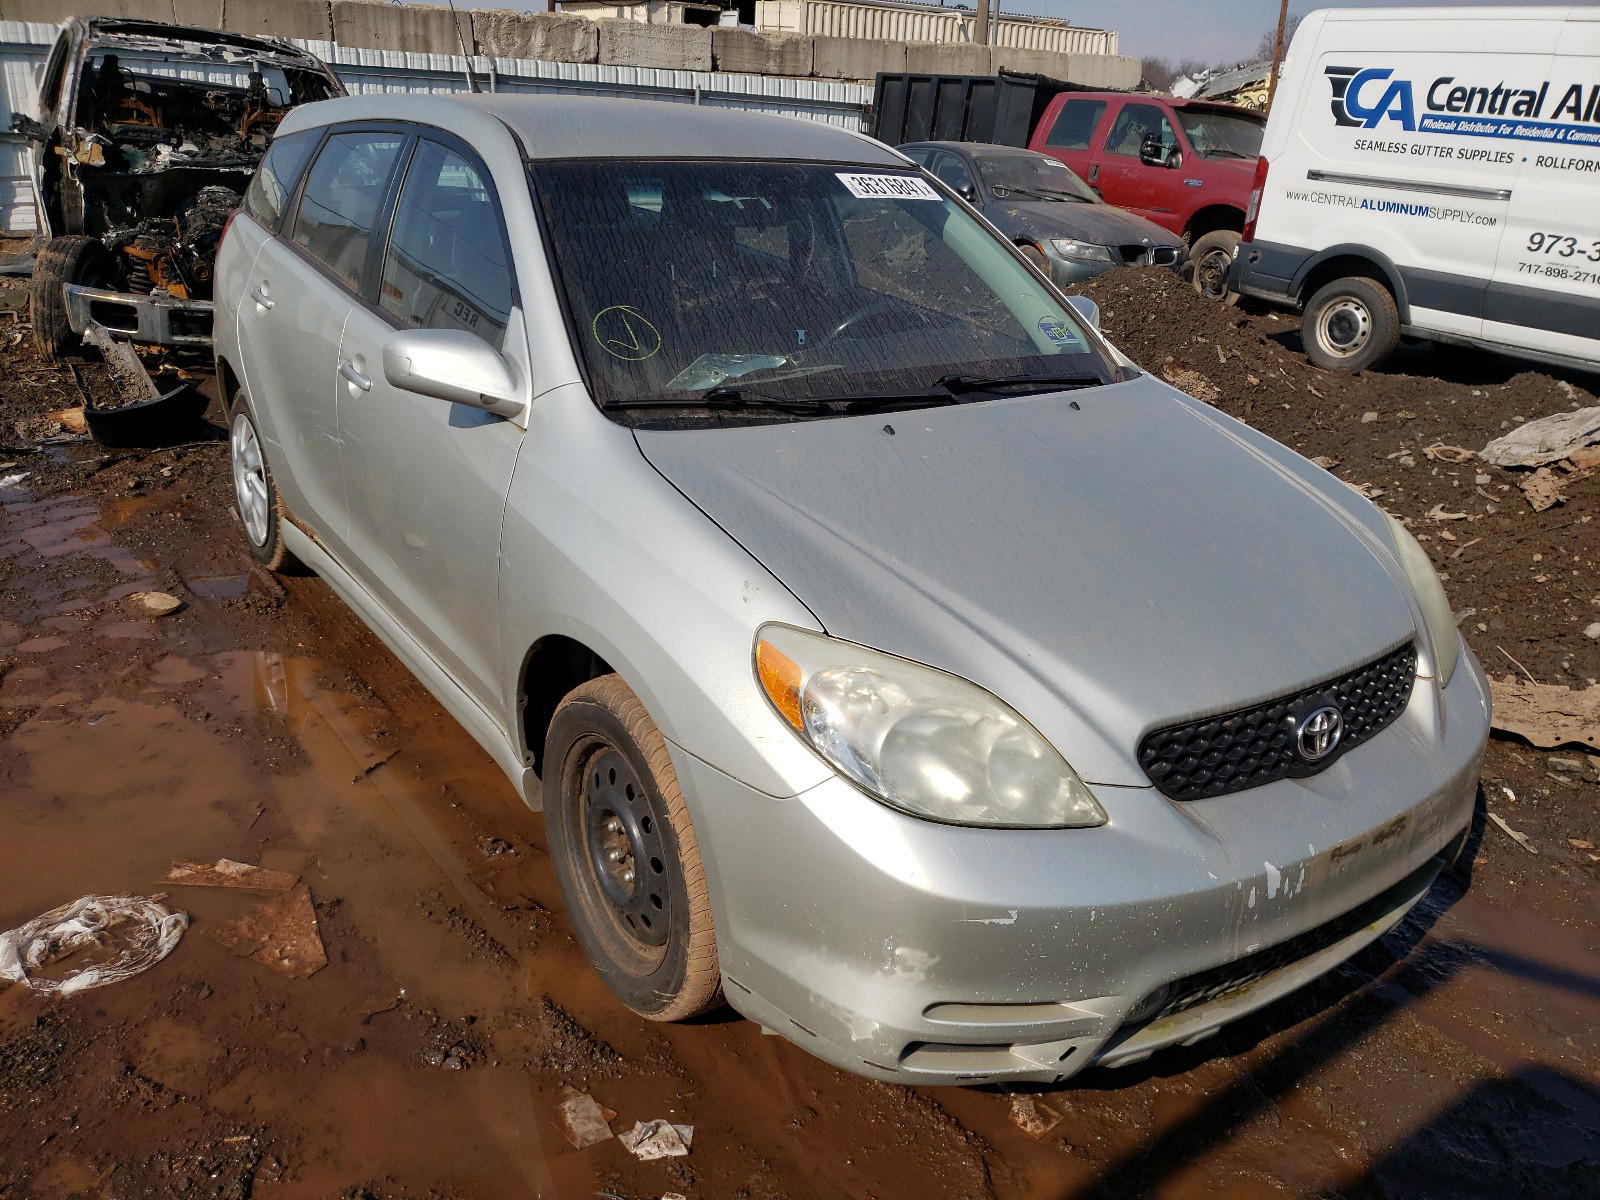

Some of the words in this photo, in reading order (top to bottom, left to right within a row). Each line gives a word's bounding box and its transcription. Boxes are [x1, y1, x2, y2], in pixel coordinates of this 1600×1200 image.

[1426, 76, 1550, 118] Central
[1422, 118, 1456, 131] Wholesale
[1457, 121, 1497, 134] Distributor
[1498, 125, 1514, 135] For
[1515, 125, 1555, 139] Residential
[1556, 128, 1566, 140] &
[1354, 139, 1408, 154] SEAMLESS
[1410, 144, 1454, 159] GUTTER
[1456, 148, 1515, 164] SUPPLIES
[850, 176, 927, 196] 36316841
